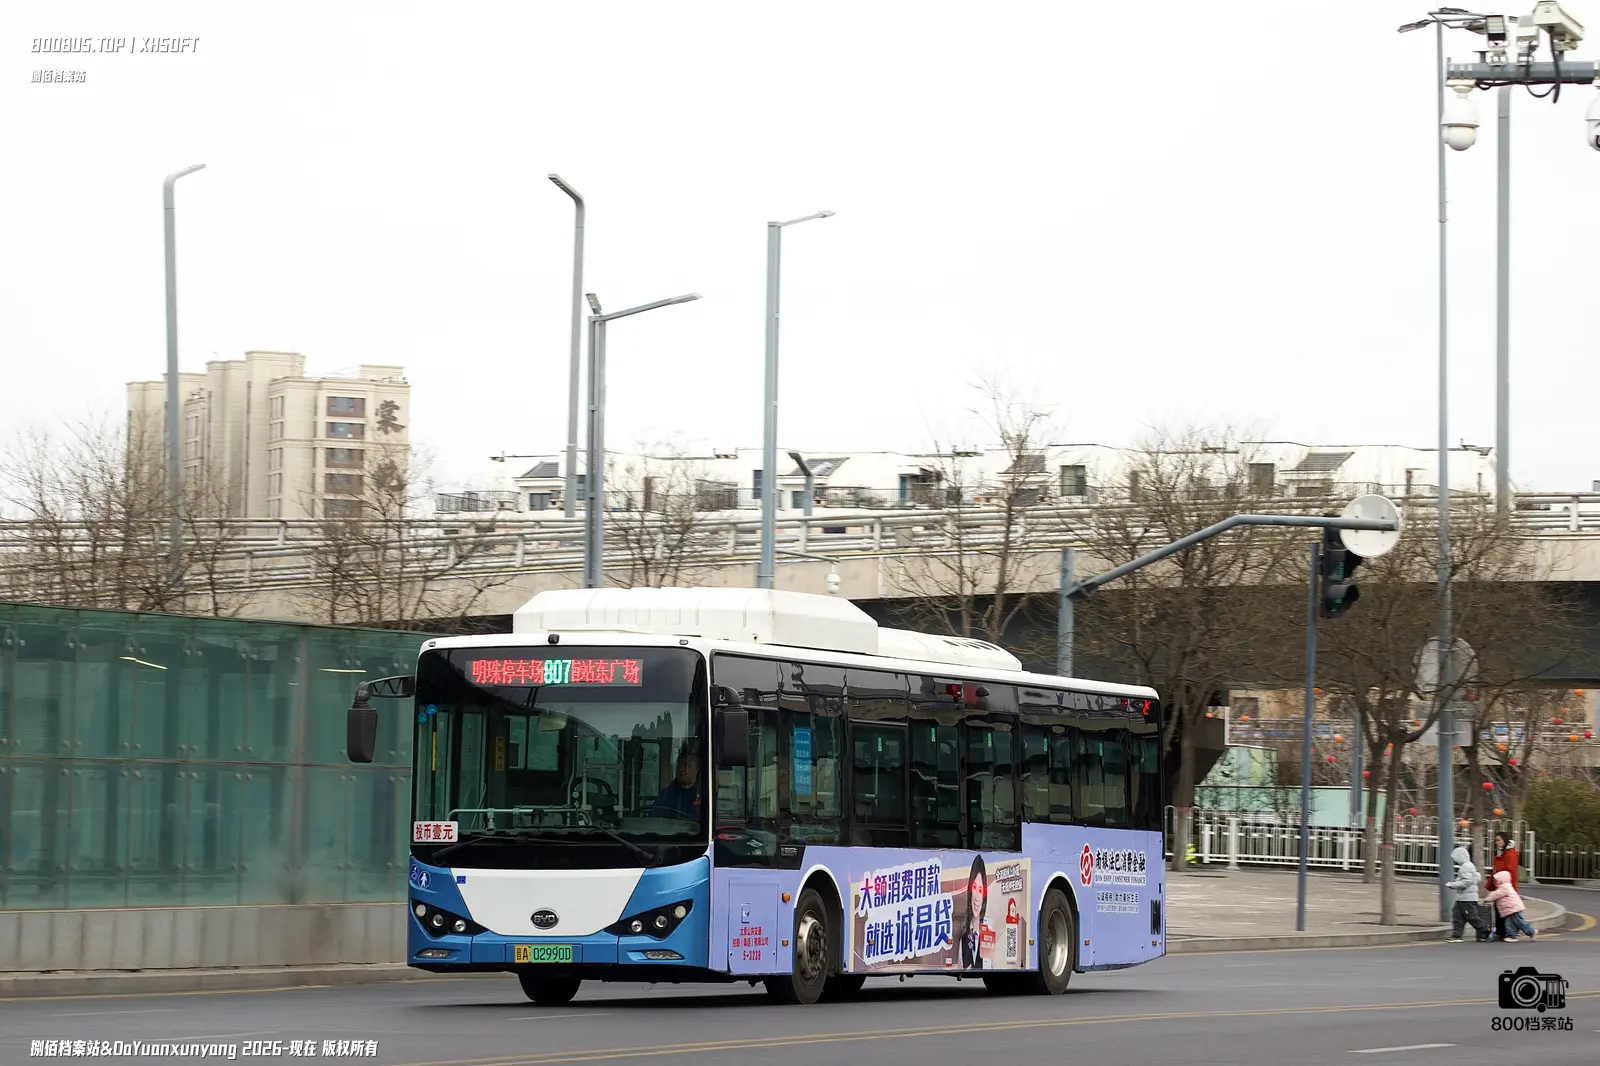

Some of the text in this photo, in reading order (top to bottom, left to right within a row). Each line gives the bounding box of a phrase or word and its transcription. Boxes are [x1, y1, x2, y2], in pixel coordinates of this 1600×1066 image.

[471, 659, 545, 685] 明珠停车场
[543, 658, 572, 685] 807
[416, 823, 454, 841] 投币壹元
[860, 863, 942, 912] 大额消费用款
[533, 914, 556, 923] BYD
[865, 898, 953, 959] 就选诚易贷
